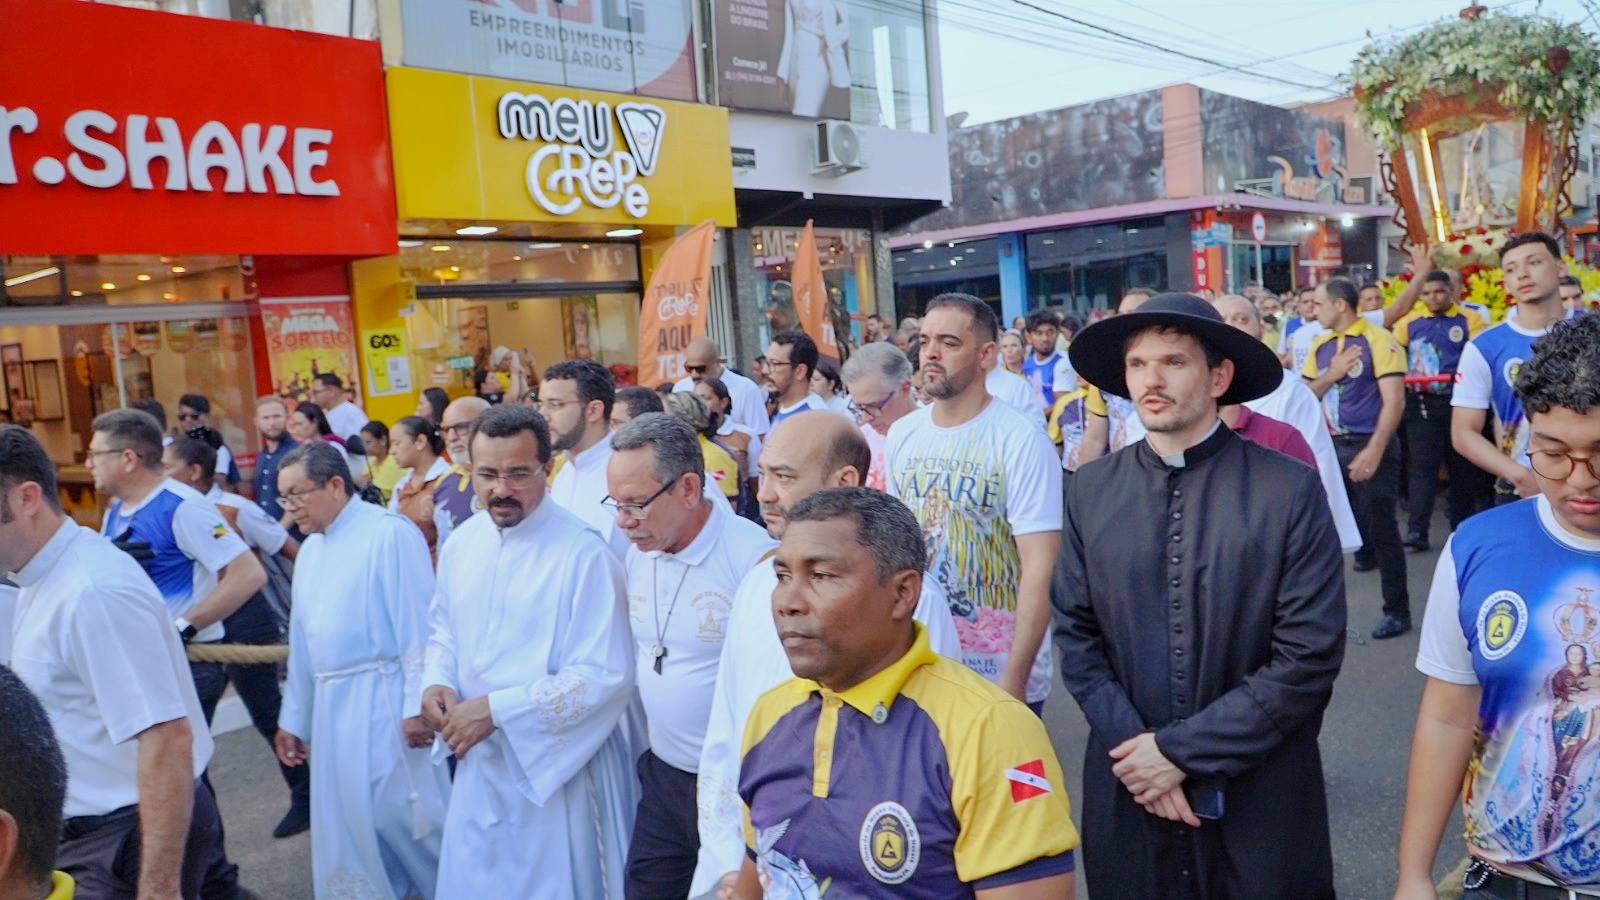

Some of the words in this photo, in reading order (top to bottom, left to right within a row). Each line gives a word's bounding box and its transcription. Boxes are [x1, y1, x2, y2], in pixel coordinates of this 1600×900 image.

[469, 9, 646, 56] EMPREENDIMENTOS
[497, 38, 624, 72] IMOBILIÁRIOS
[271, 331, 351, 350] SORTEIO
